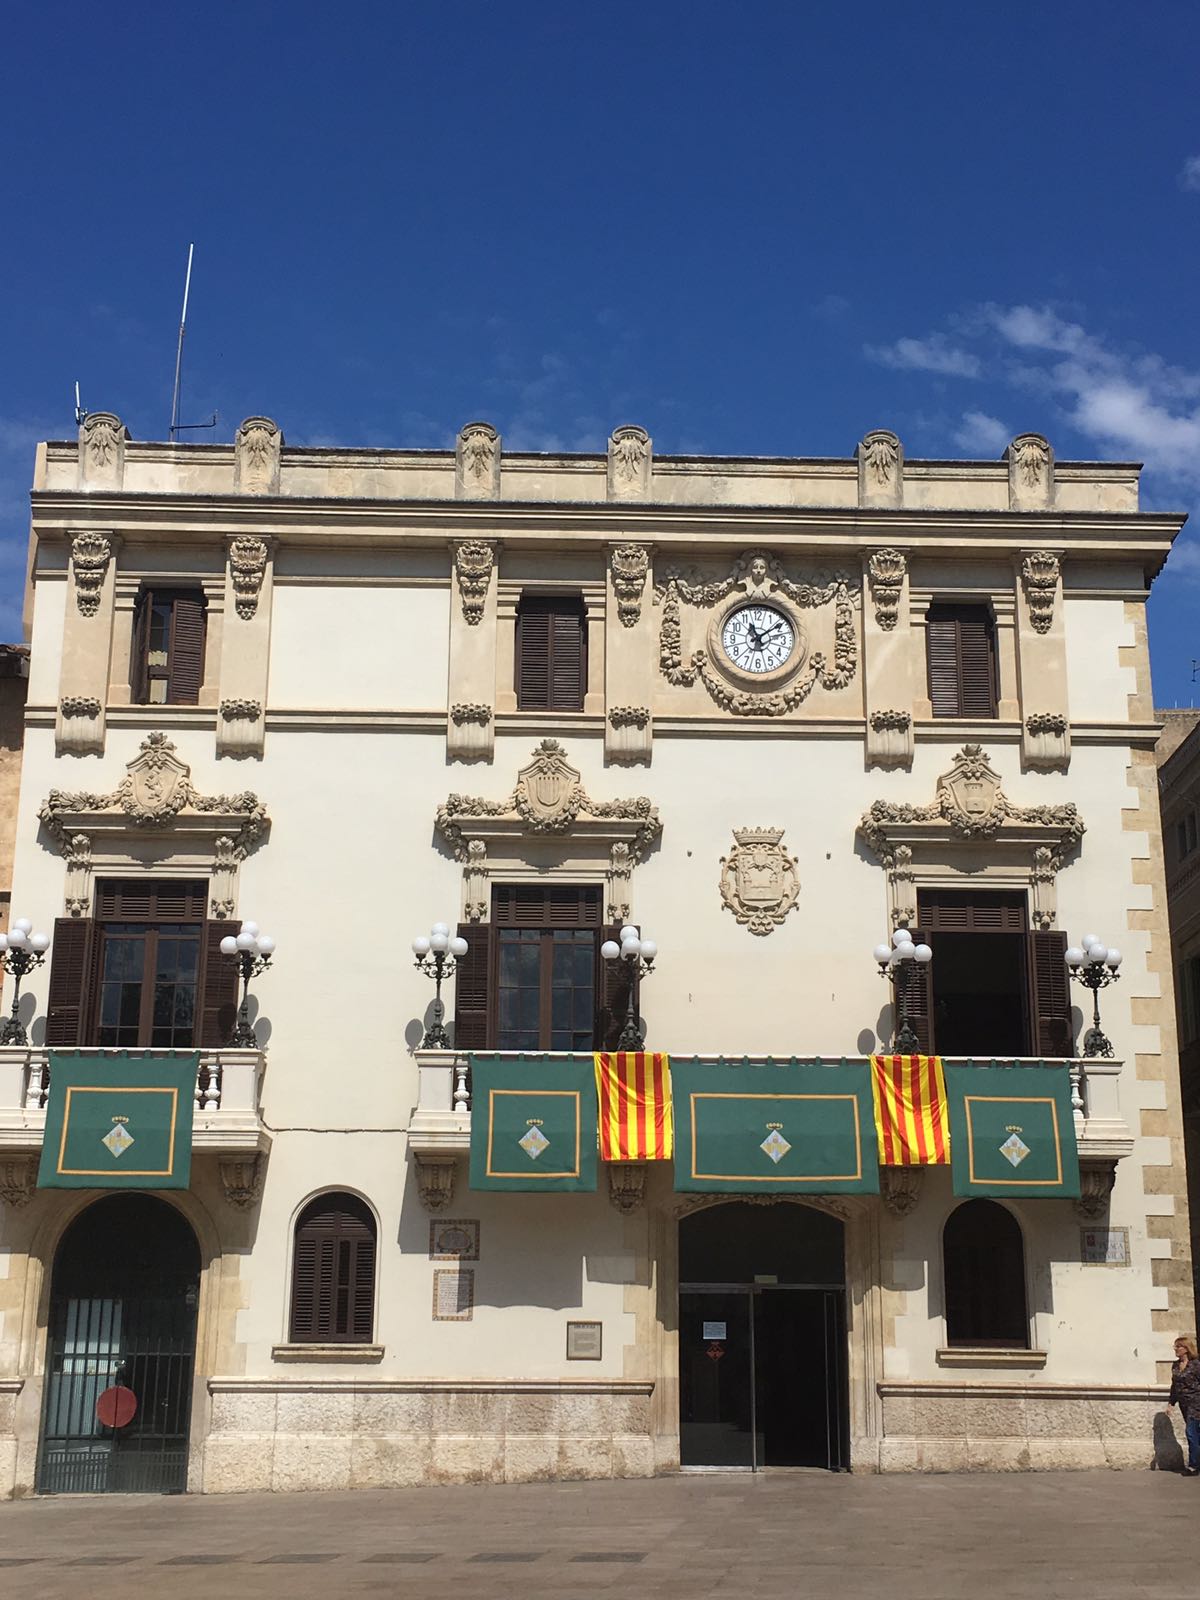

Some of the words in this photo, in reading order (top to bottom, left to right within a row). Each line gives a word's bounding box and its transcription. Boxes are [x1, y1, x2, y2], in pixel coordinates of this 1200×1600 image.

[742, 614, 748, 624] 11
[754, 611, 762, 621] 12
[768, 615, 772, 624] 1
[732, 622, 741, 632] 10
[730, 634, 736, 644] 9
[780, 636, 786, 645] 3
[733, 647, 739, 656] 8
[776, 648, 781, 657] 4
[744, 656, 749, 666] 7
[755, 659, 761, 669] 6
[768, 656, 774, 666] 5
